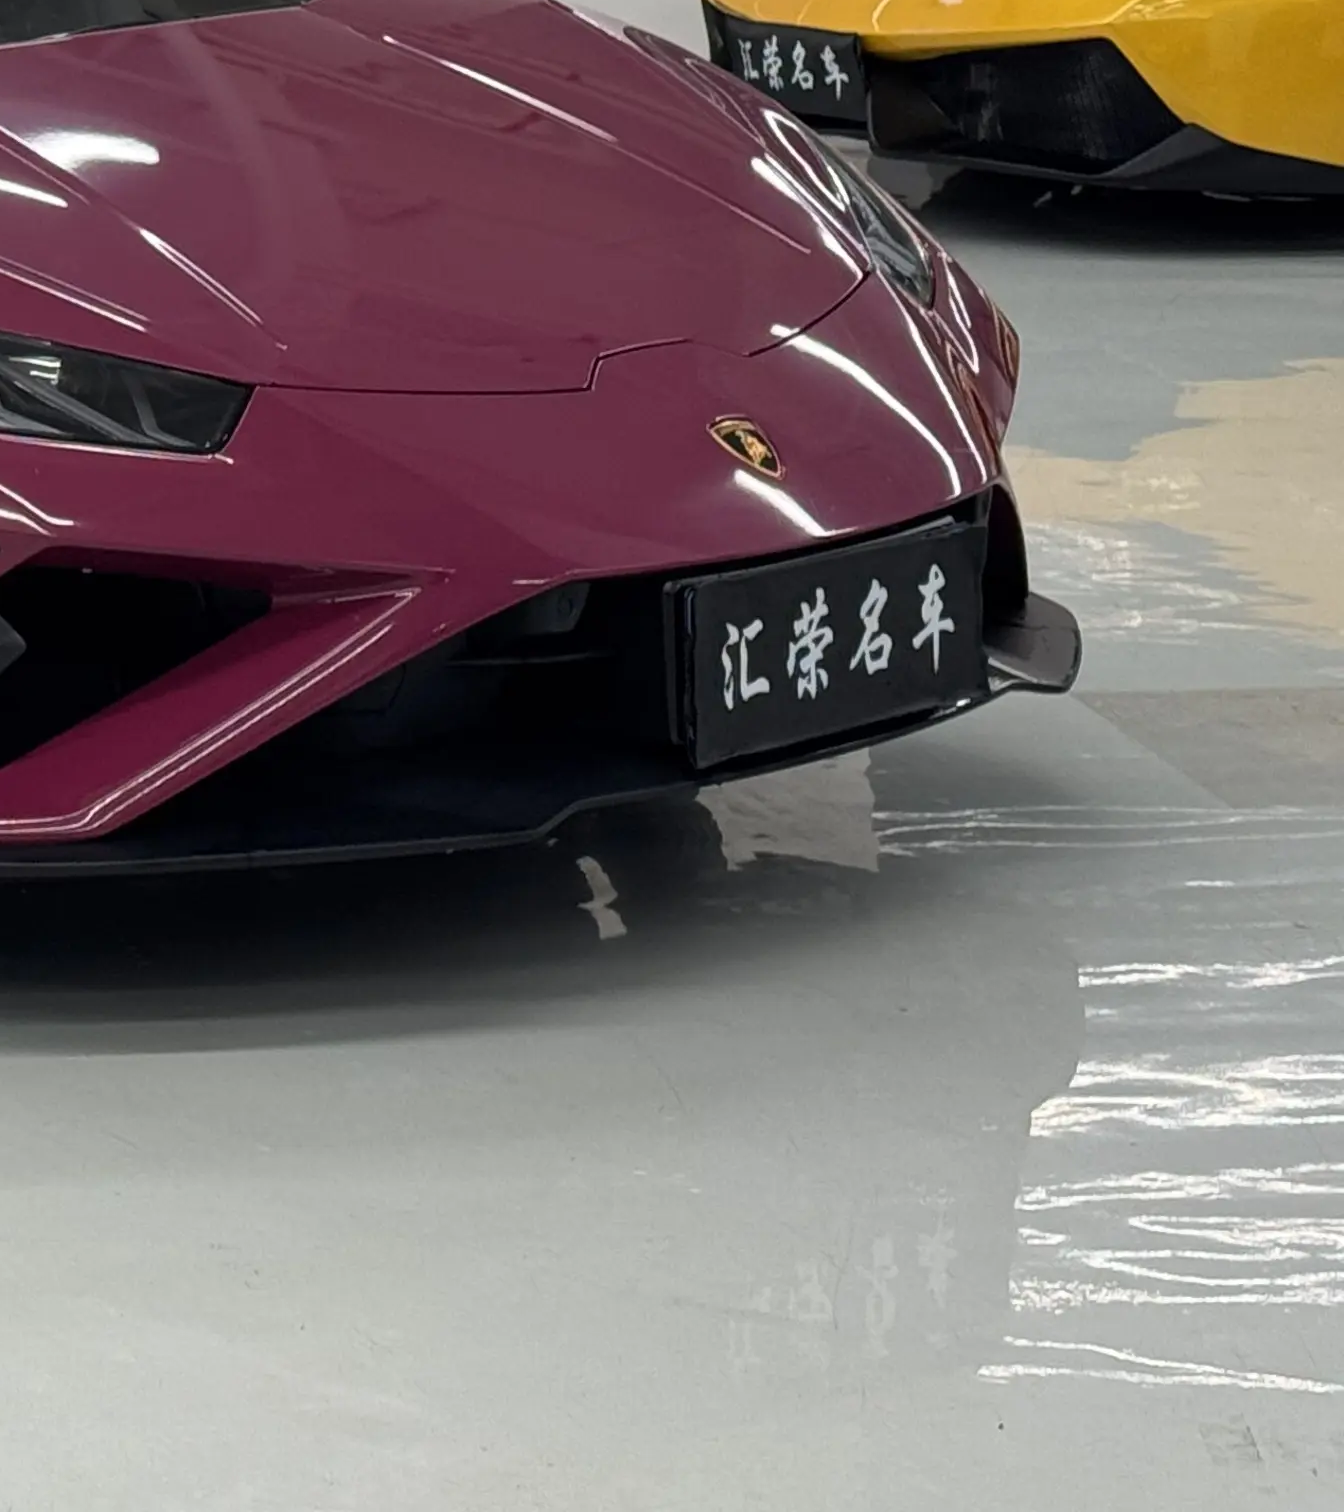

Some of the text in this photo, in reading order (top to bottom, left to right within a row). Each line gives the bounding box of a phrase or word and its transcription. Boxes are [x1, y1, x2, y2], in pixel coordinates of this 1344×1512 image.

[738, 34, 850, 101] 汇荣名车
[720, 563, 956, 711] 汇荣名车
